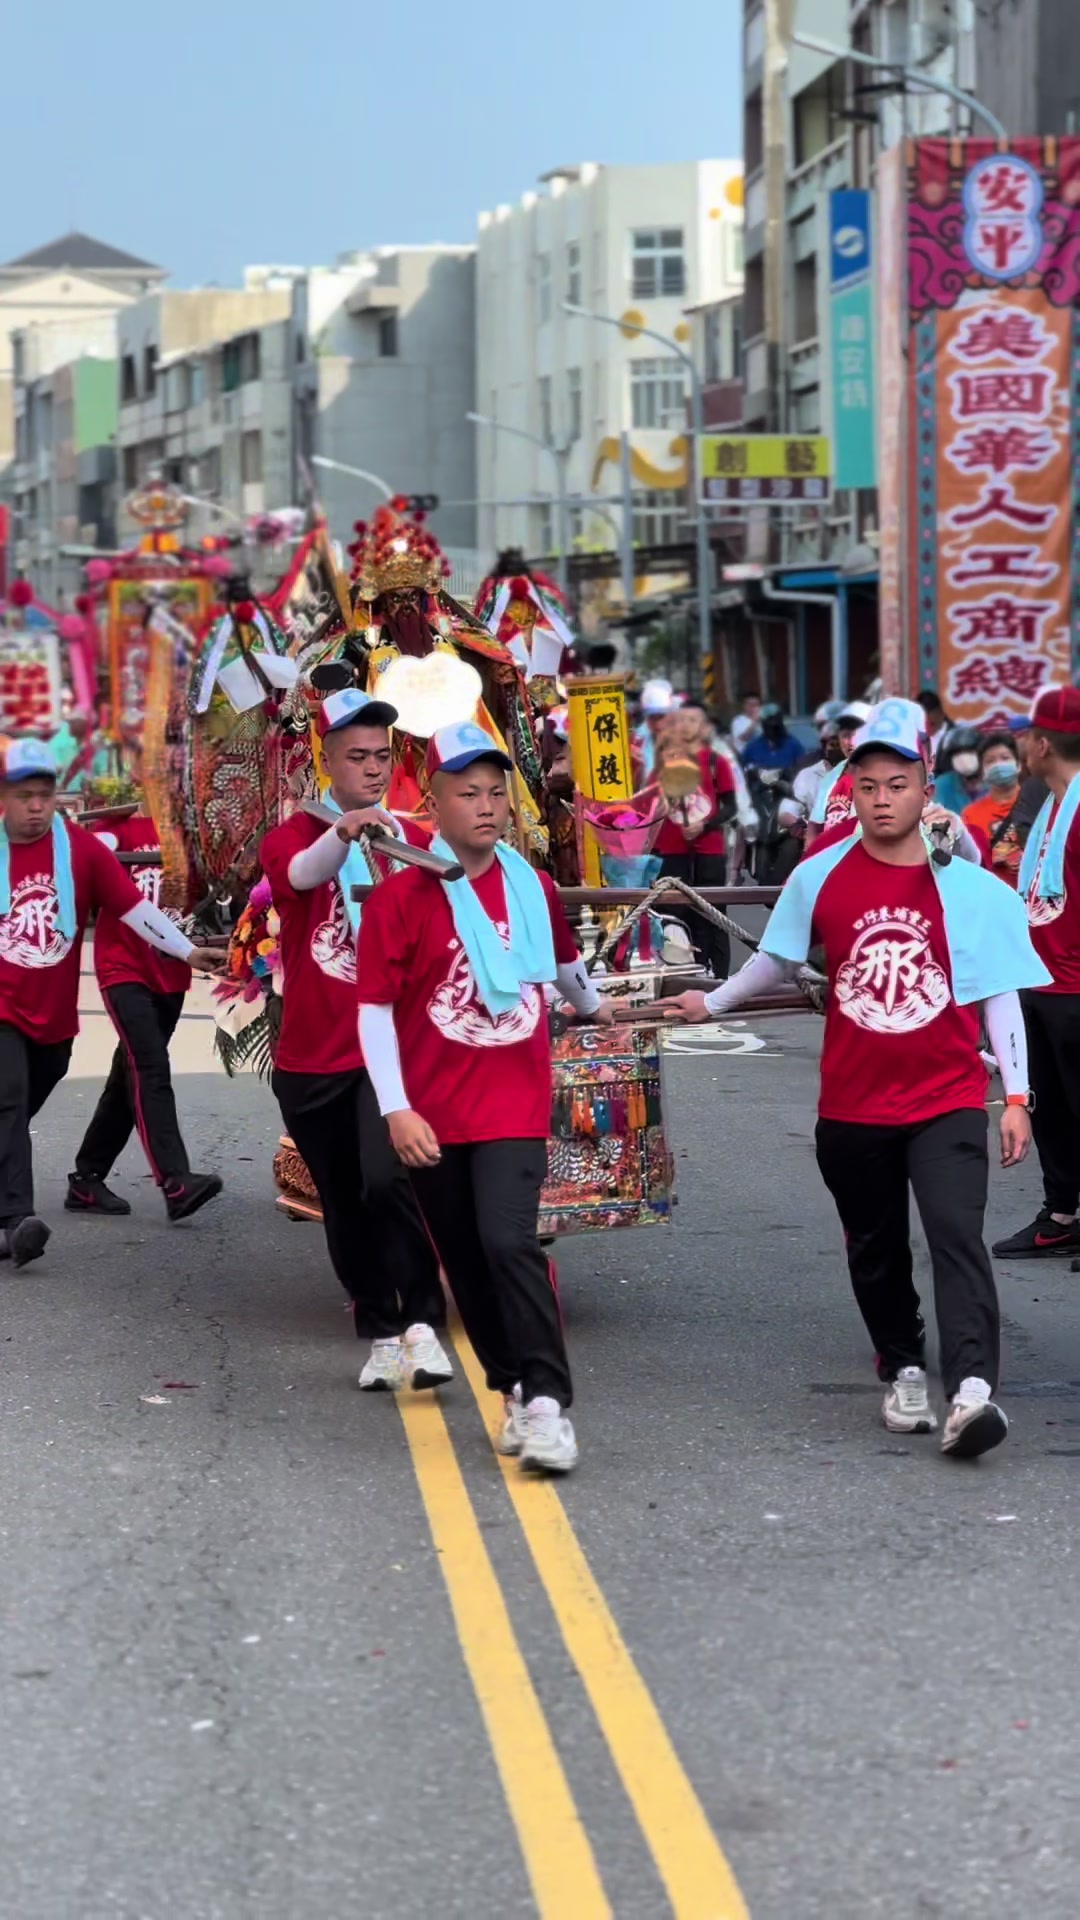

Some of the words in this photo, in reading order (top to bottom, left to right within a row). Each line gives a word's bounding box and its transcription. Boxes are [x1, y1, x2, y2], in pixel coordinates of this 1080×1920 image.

[977, 165, 1029, 270] 安平
[948, 308, 1058, 733] 美國華人工商總
[592, 712, 623, 799] 保護
